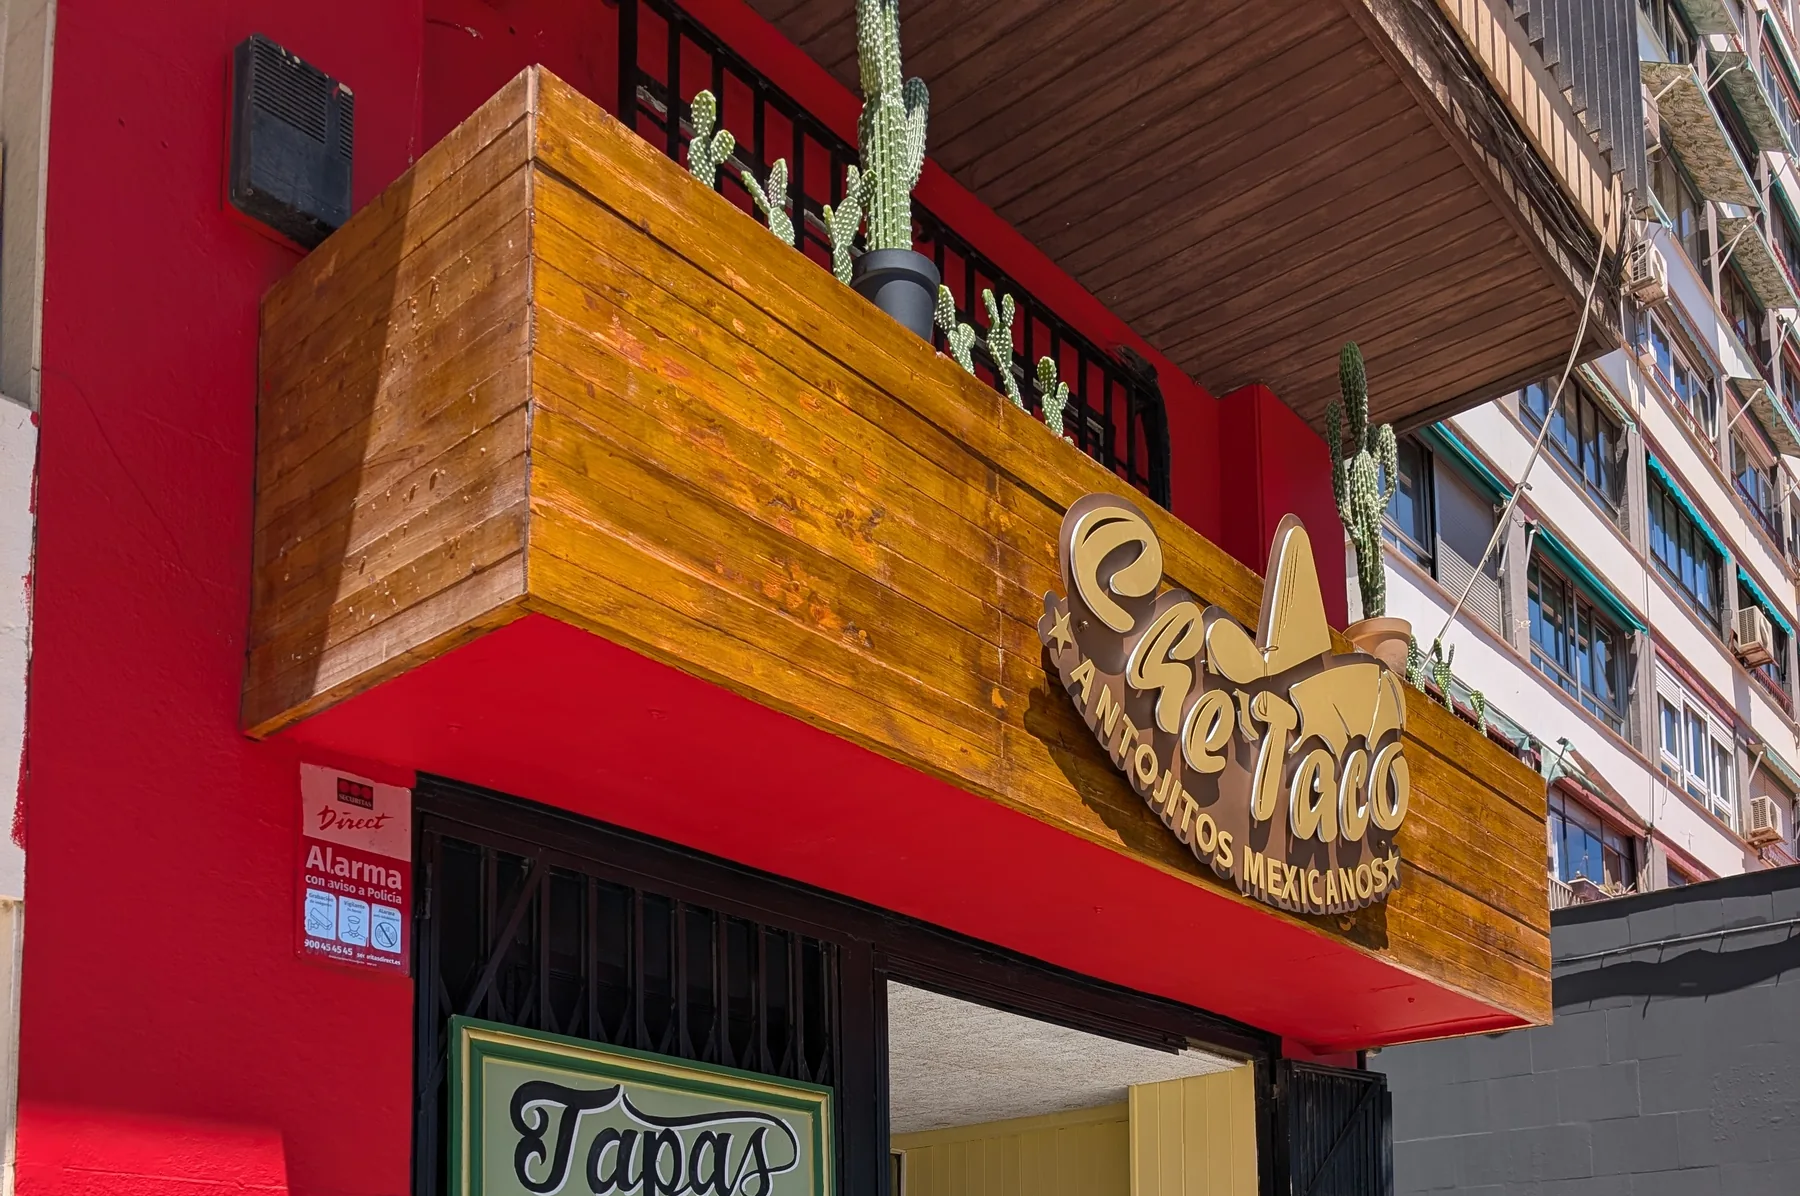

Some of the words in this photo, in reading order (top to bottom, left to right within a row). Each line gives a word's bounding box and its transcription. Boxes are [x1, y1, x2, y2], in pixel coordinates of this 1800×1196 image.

[1070, 658, 1234, 869] ANTOJITOS
[1242, 845, 1388, 904] MEXICANOS
[338, 793, 372, 808] SECURITAS
[316, 804, 395, 831] Direct
[305, 845, 403, 891] Alarma
[305, 874, 326, 888] con
[327, 879, 356, 895] aviso
[358, 886, 365, 897] a
[367, 887, 402, 905] Policía
[304, 938, 321, 950] 900
[321, 943, 331, 952] 45
[332, 945, 342, 953] 45
[342, 946, 353, 956] 45
